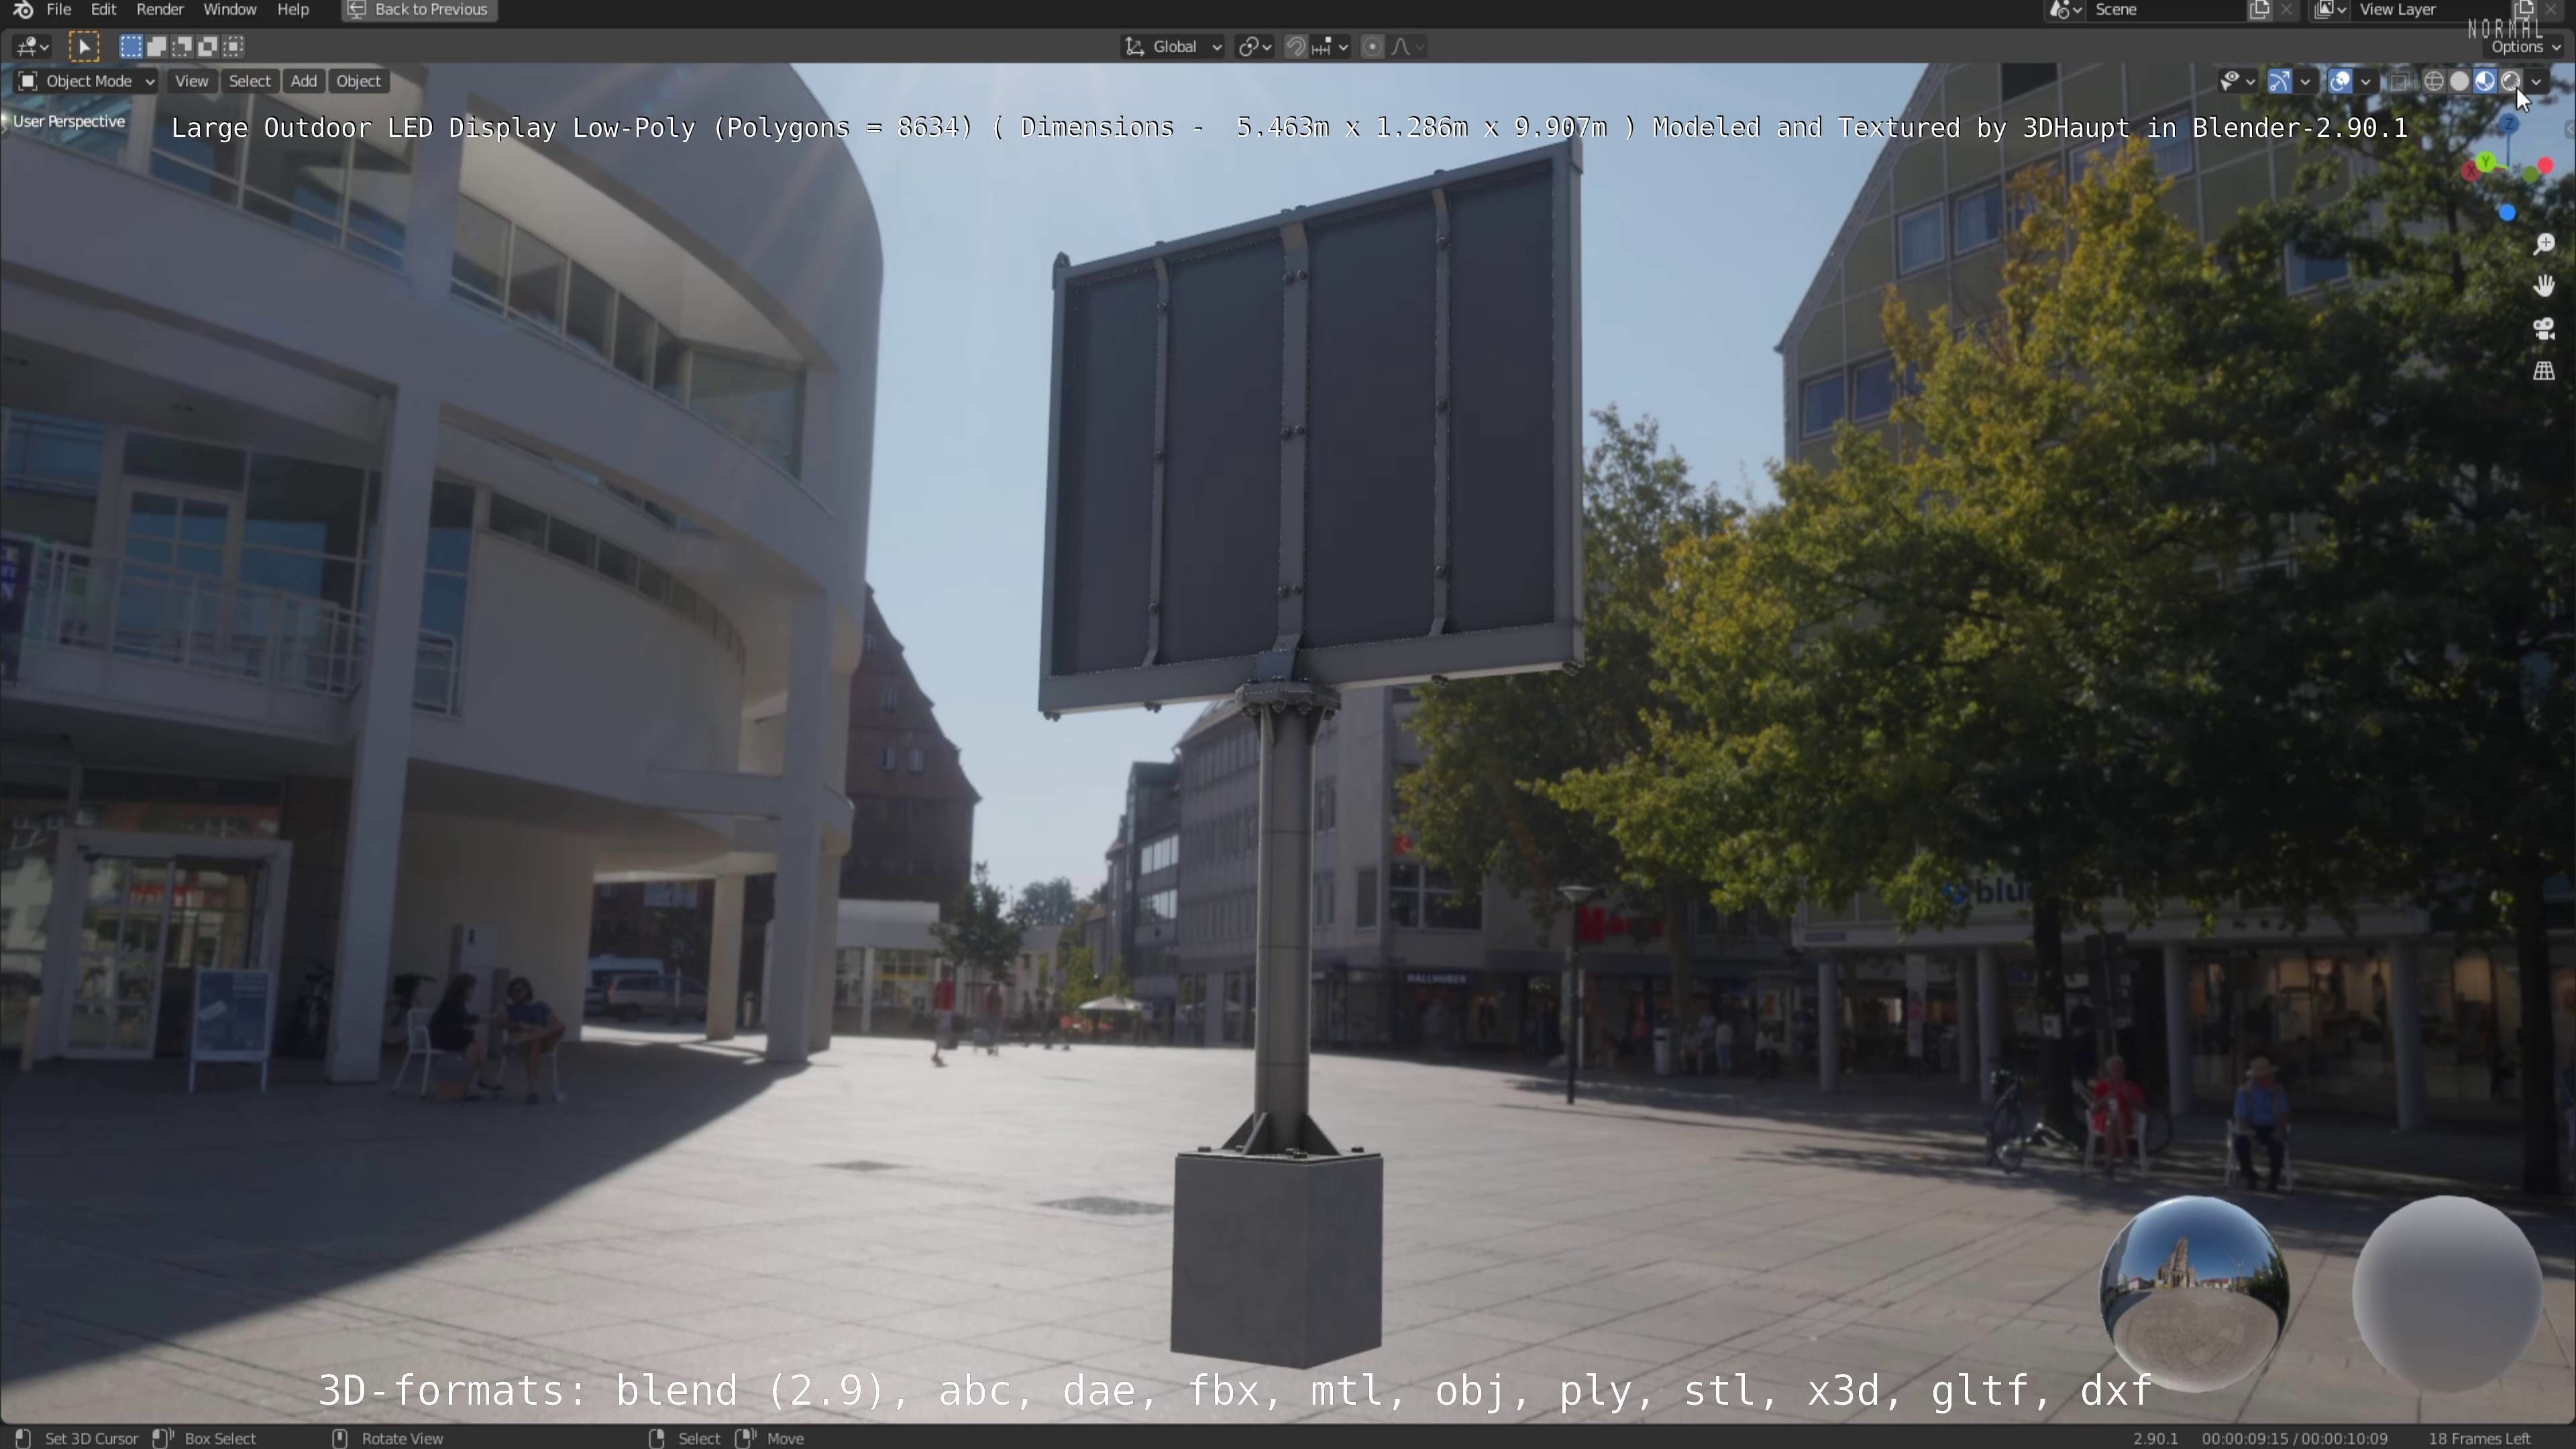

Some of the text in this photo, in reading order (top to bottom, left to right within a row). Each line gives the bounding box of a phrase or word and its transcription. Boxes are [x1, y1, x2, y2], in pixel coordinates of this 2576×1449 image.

[47, 3, 72, 15] File
[91, 3, 117, 15] Edit
[137, 3, 184, 15] Render
[204, 3, 257, 15] Window
[278, 3, 309, 19] Help
[376, 3, 487, 15] Back to Previous
[2096, 3, 2137, 15] Scene
[2360, 3, 2436, 18] View Layer
[1154, 40, 1196, 53] Global
[2492, 40, 2544, 56] Options
[47, 74, 131, 90] Object Mode
[175, 75, 209, 87] View
[230, 74, 271, 87] Select
[291, 74, 317, 87] Add
[337, 74, 381, 90] Object
[13, 115, 125, 130] User Perspective
[46, 1432, 140, 1445] Set 3D Cursor
[185, 1432, 257, 1445] Box Select
[362, 1432, 444, 1445] Rotate View
[679, 1432, 721, 1445] Select
[768, 1432, 804, 1445] Move
[2134, 1432, 2178, 1445] 2.90.1
[2202, 1432, 2289, 1445] 00:00:09:15
[2302, 1432, 2388, 1445] 00:00:10:09
[2430, 1432, 2531, 1445] 18 Frames Left
